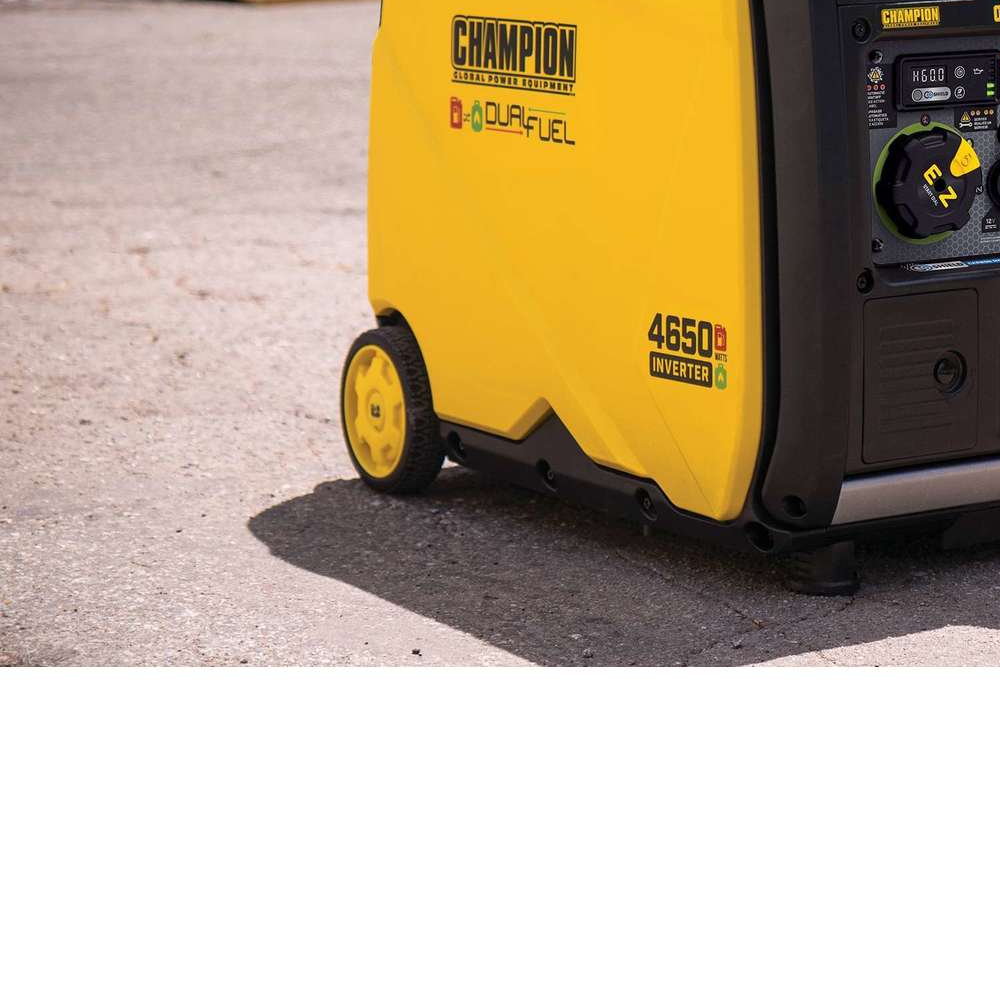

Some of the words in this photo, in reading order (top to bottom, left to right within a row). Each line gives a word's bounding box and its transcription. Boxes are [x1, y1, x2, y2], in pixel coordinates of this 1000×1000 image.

[882, 7, 939, 24] CHAMPION
[453, 19, 575, 78] CHAMPION
[453, 71, 486, 83] GLOBAL
[488, 75, 518, 87] POWER
[521, 78, 574, 93] EQUIPMENT
[485, 101, 530, 130] DUAL
[525, 116, 576, 146] FUEL
[647, 312, 713, 359] 4650
[652, 356, 709, 383] INVERTER
